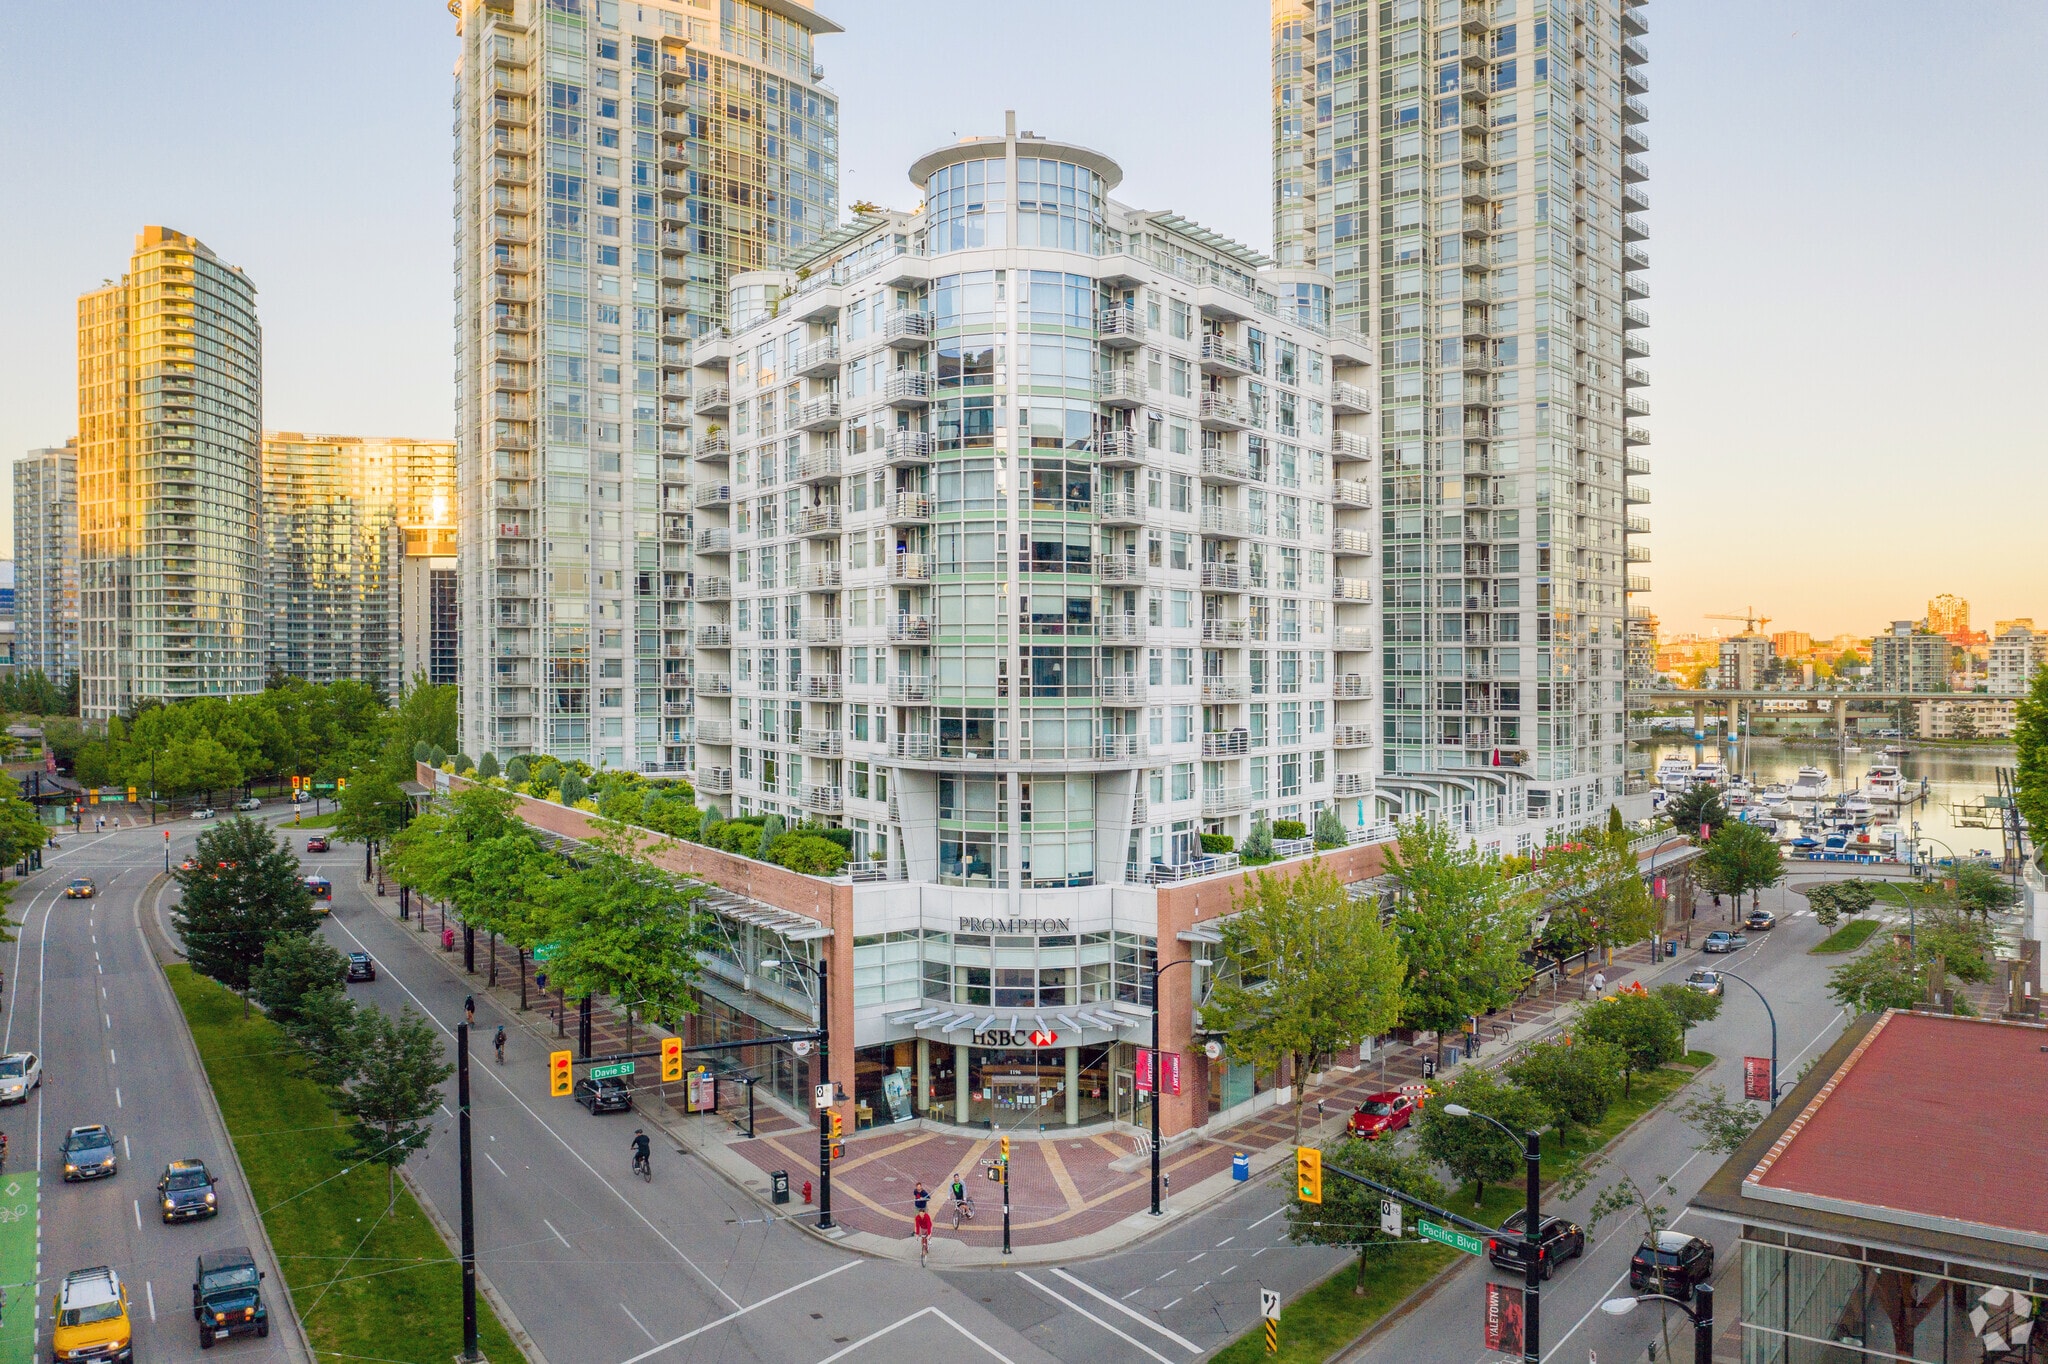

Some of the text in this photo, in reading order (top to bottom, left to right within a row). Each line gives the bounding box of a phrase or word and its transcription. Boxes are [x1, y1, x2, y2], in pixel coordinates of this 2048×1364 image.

[959, 916, 1071, 933] PROMPTON
[972, 1028, 1027, 1046] HSBC
[594, 1065, 630, 1078] Davie St
[1423, 1223, 1477, 1251] Pacific Blvd
[1489, 1291, 1499, 1338] YALETOWN
